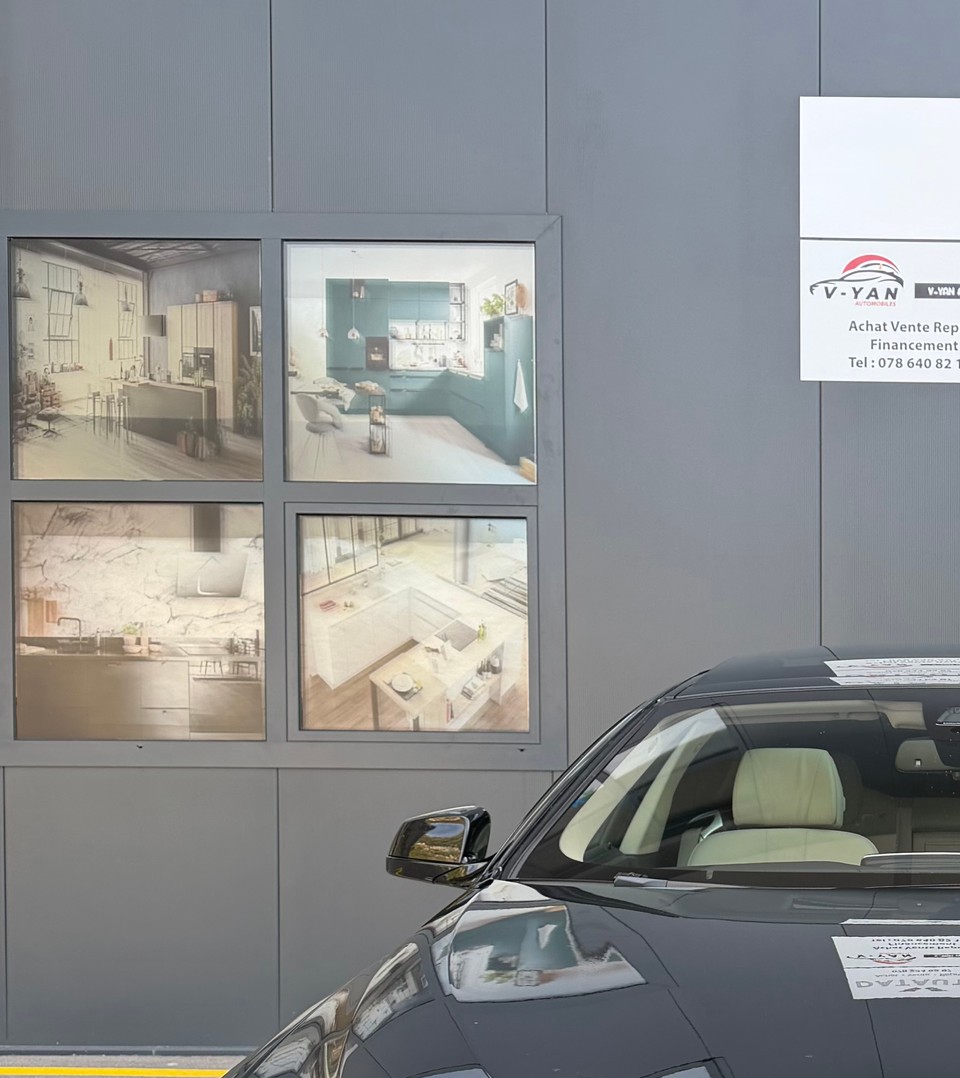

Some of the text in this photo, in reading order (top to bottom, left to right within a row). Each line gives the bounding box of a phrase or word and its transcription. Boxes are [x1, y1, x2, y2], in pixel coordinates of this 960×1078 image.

[824, 286, 899, 300] V-YAN
[927, 286, 956, 296] V-YAN
[848, 320, 888, 332] Achat
[890, 320, 930, 333] Vente
[870, 338, 959, 351] Financement
[848, 356, 868, 368] Tel
[878, 357, 904, 368] 078
[906, 357, 932, 369] 640
[935, 358, 952, 369] 82
